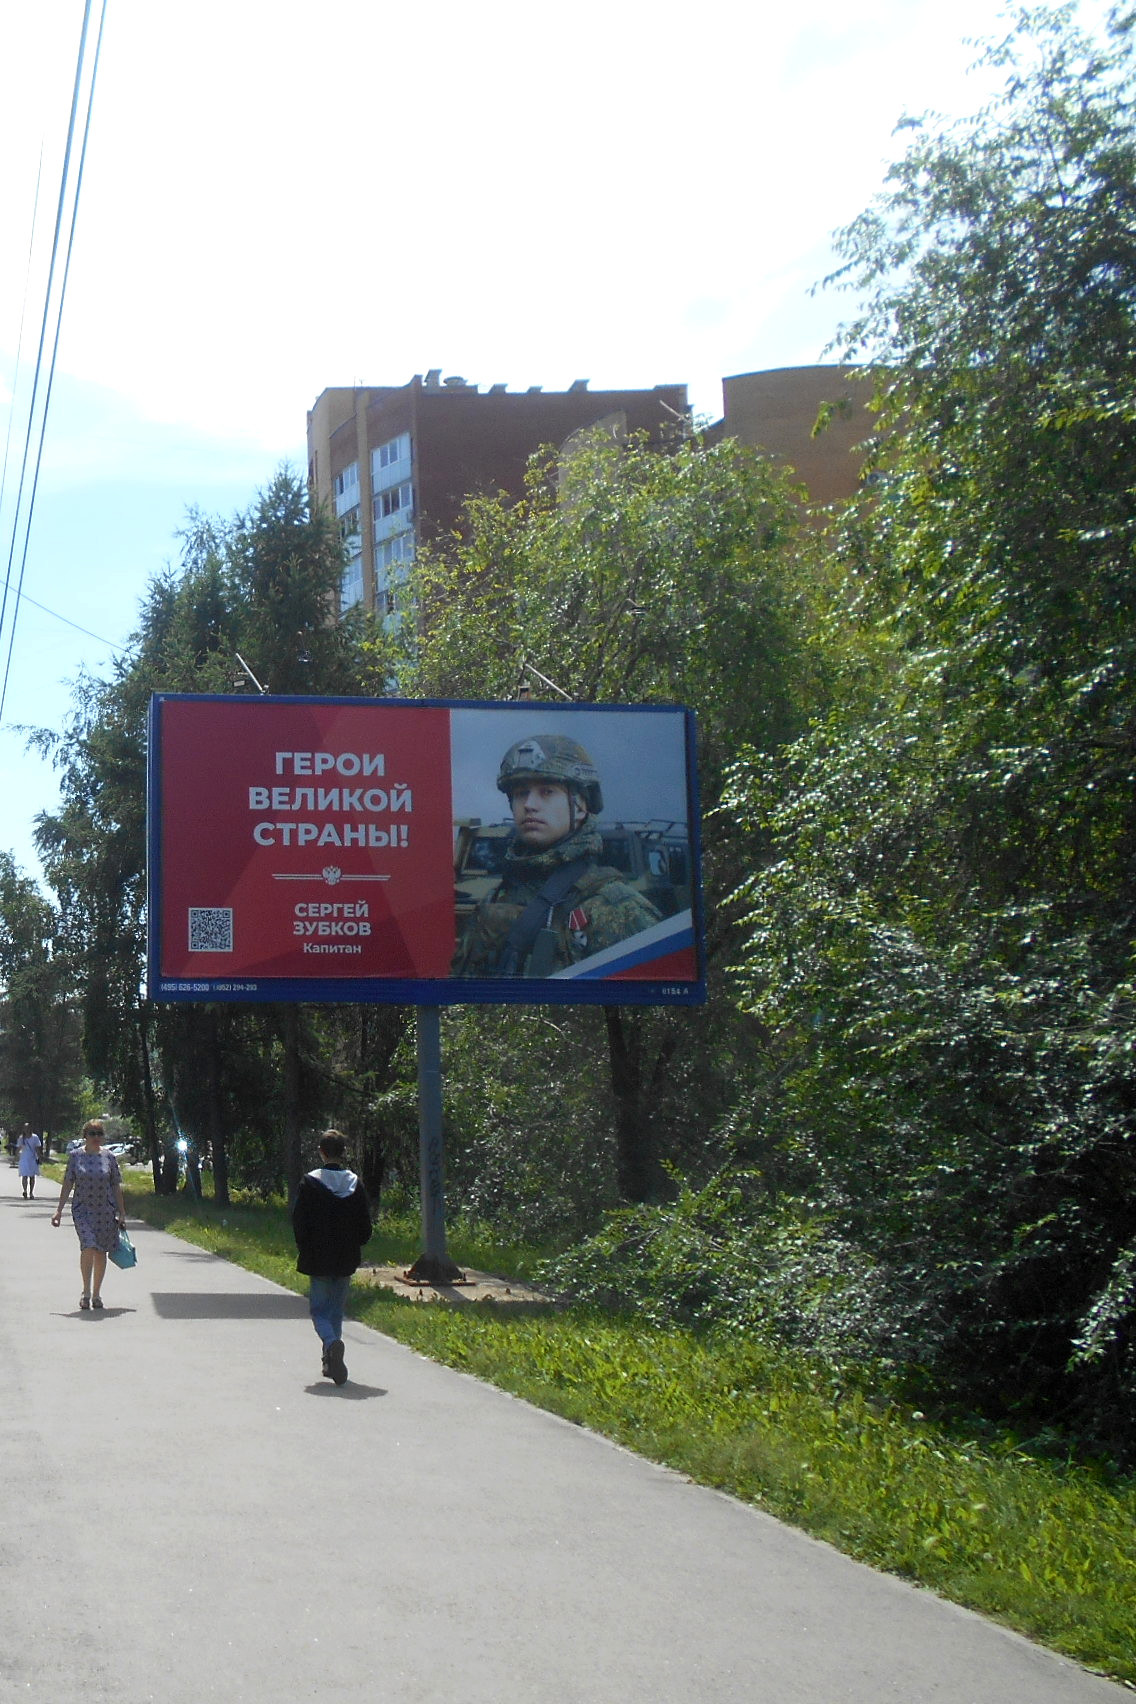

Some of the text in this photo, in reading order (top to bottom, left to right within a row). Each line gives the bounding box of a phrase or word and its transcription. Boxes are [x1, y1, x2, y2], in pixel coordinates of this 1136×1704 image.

[275, 751, 385, 777] ГЕРОИ
[248, 783, 413, 812] ВЕЛИКОЙ
[252, 822, 409, 848] СТРАНЫ!
[294, 900, 369, 918] СЕРГЕЙ
[292, 921, 372, 936] ЗУБКОВ
[303, 942, 362, 954] Капитан
